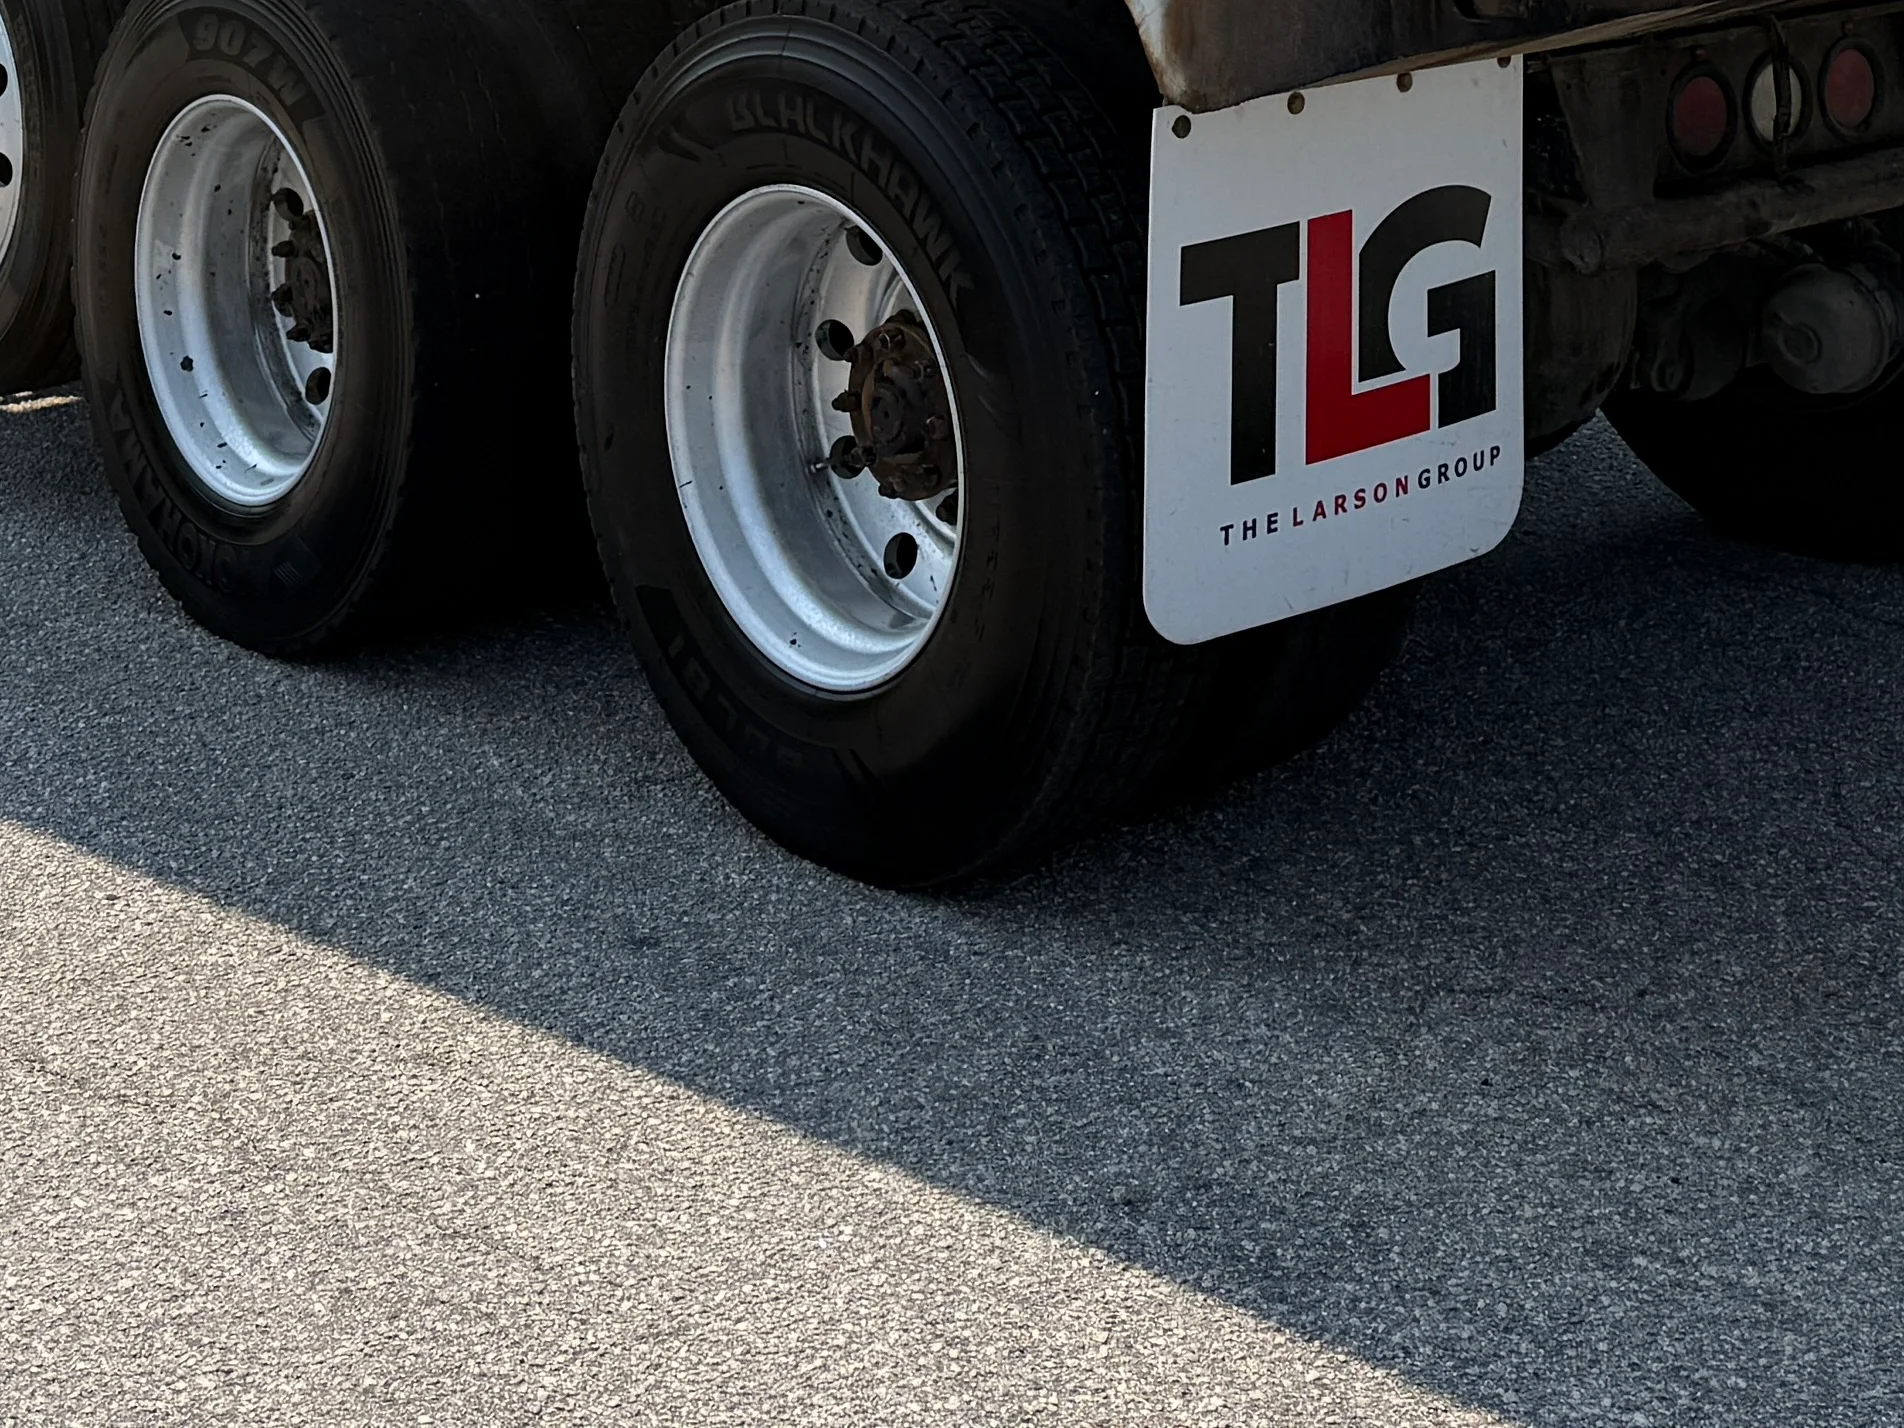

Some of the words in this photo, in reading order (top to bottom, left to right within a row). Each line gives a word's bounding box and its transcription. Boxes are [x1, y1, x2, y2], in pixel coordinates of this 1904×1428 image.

[193, 12, 310, 107] 907W
[725, 89, 976, 308] BLACKHAWK
[1179, 184, 1497, 486] TLG
[1220, 511, 1279, 546] THE
[1292, 475, 1409, 528] LARSON
[1418, 445, 1502, 490] GROUP
